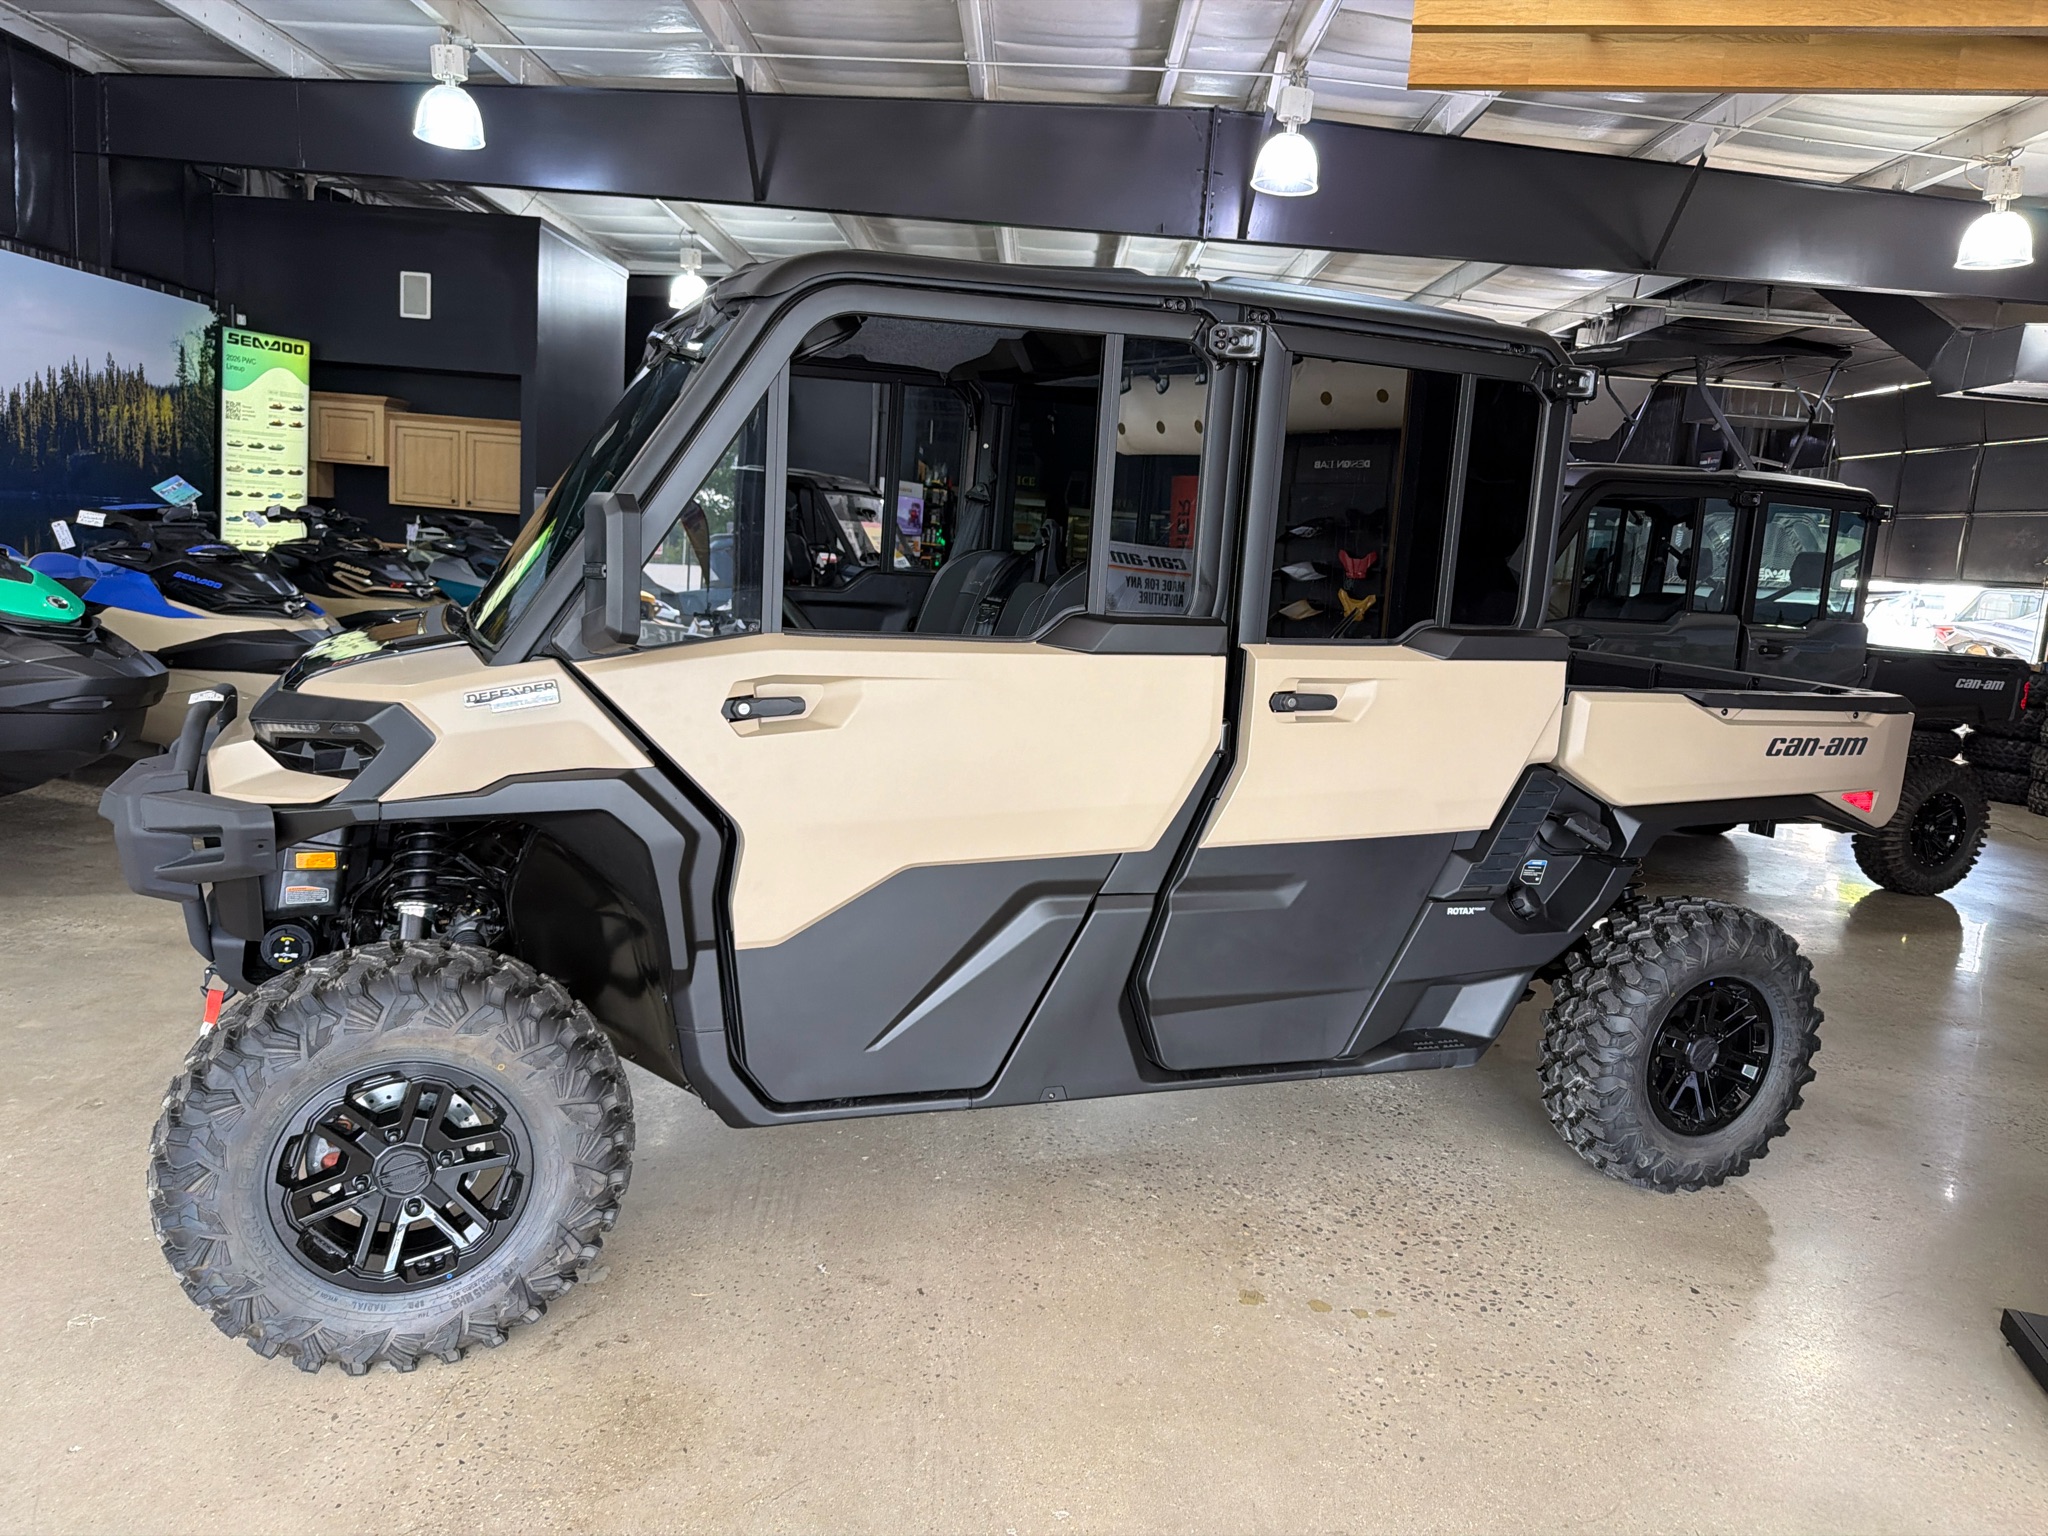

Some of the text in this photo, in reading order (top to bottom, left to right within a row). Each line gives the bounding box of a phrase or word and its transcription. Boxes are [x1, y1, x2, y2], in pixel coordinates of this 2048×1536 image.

[226, 362, 246, 373] Lineup
[1954, 677, 2006, 691] can-am
[466, 682, 555, 703] DEFENDER
[1765, 736, 1869, 757] can-am
[1446, 907, 1475, 916] ROTAX
